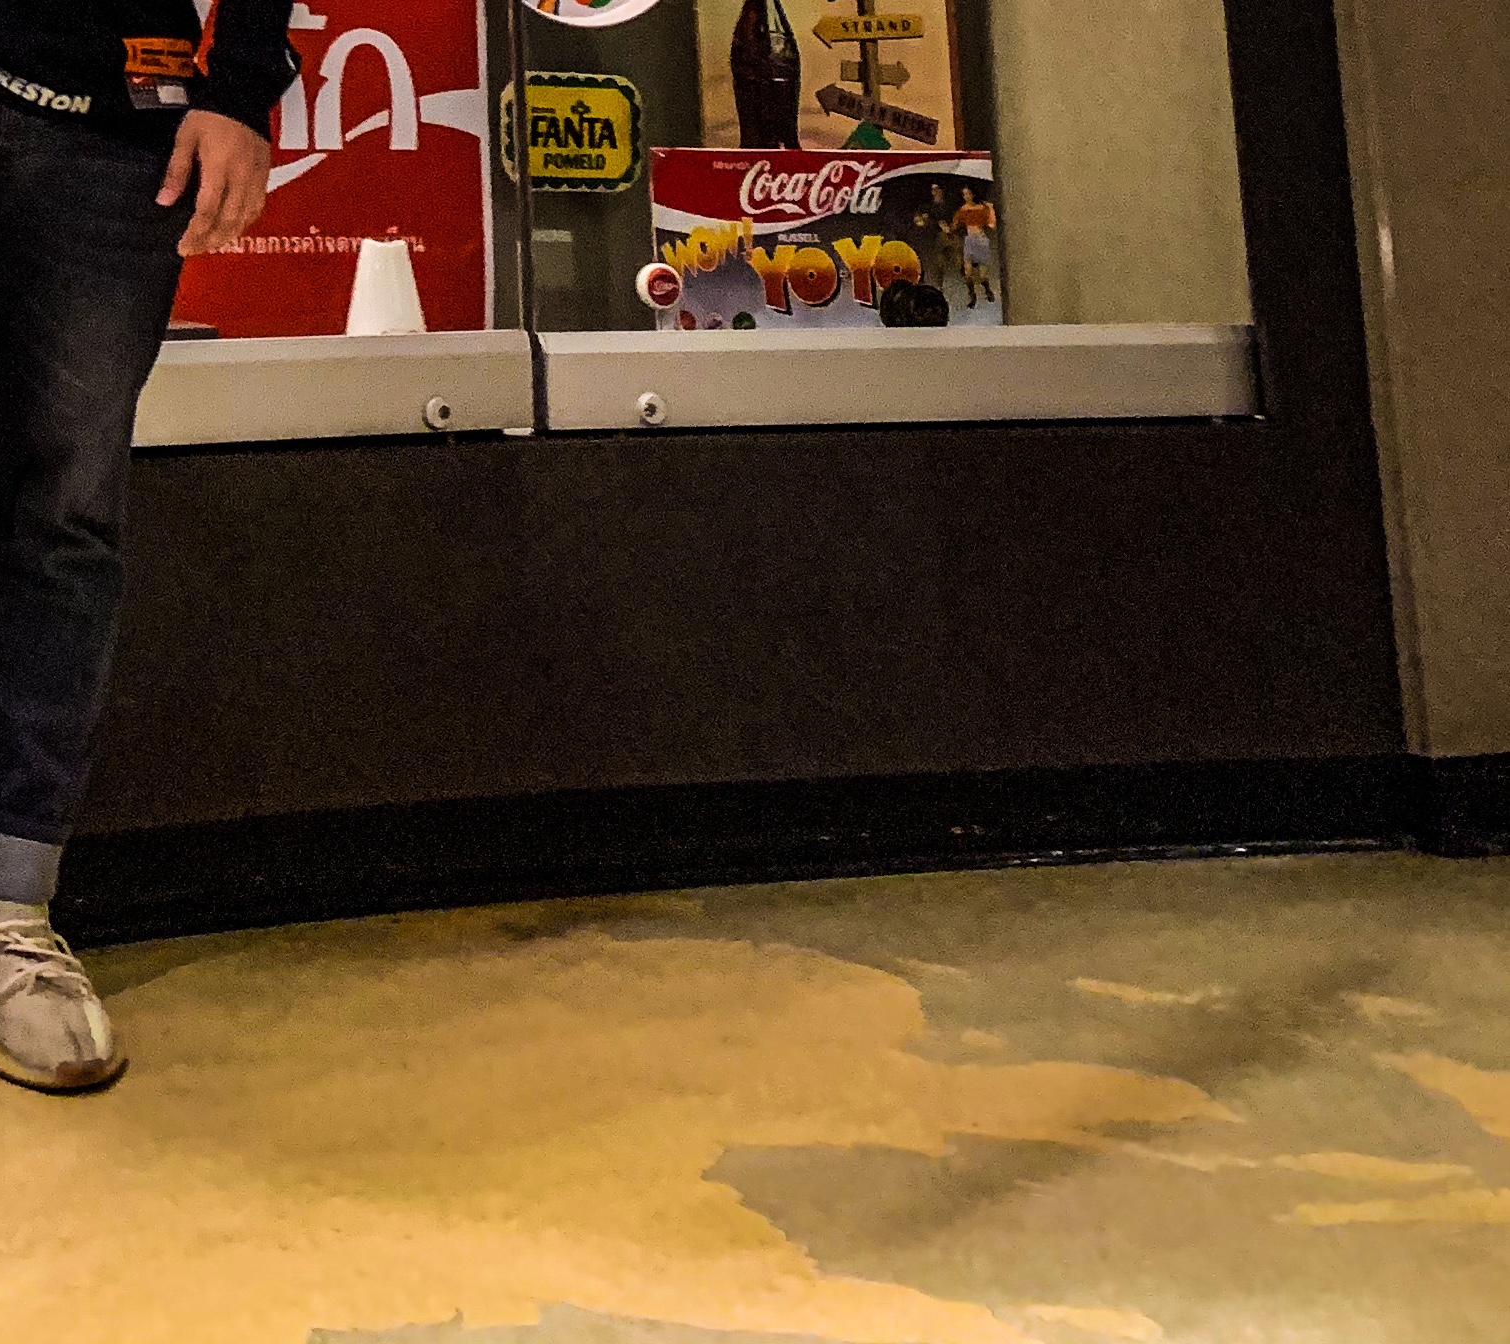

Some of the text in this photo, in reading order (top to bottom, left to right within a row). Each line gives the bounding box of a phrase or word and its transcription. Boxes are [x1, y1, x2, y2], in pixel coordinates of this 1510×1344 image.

[840, 19, 912, 34] STRAND
[529, 109, 618, 150] FANTA
[543, 152, 607, 172] POMELO
[740, 160, 884, 214] Coca-Cola
